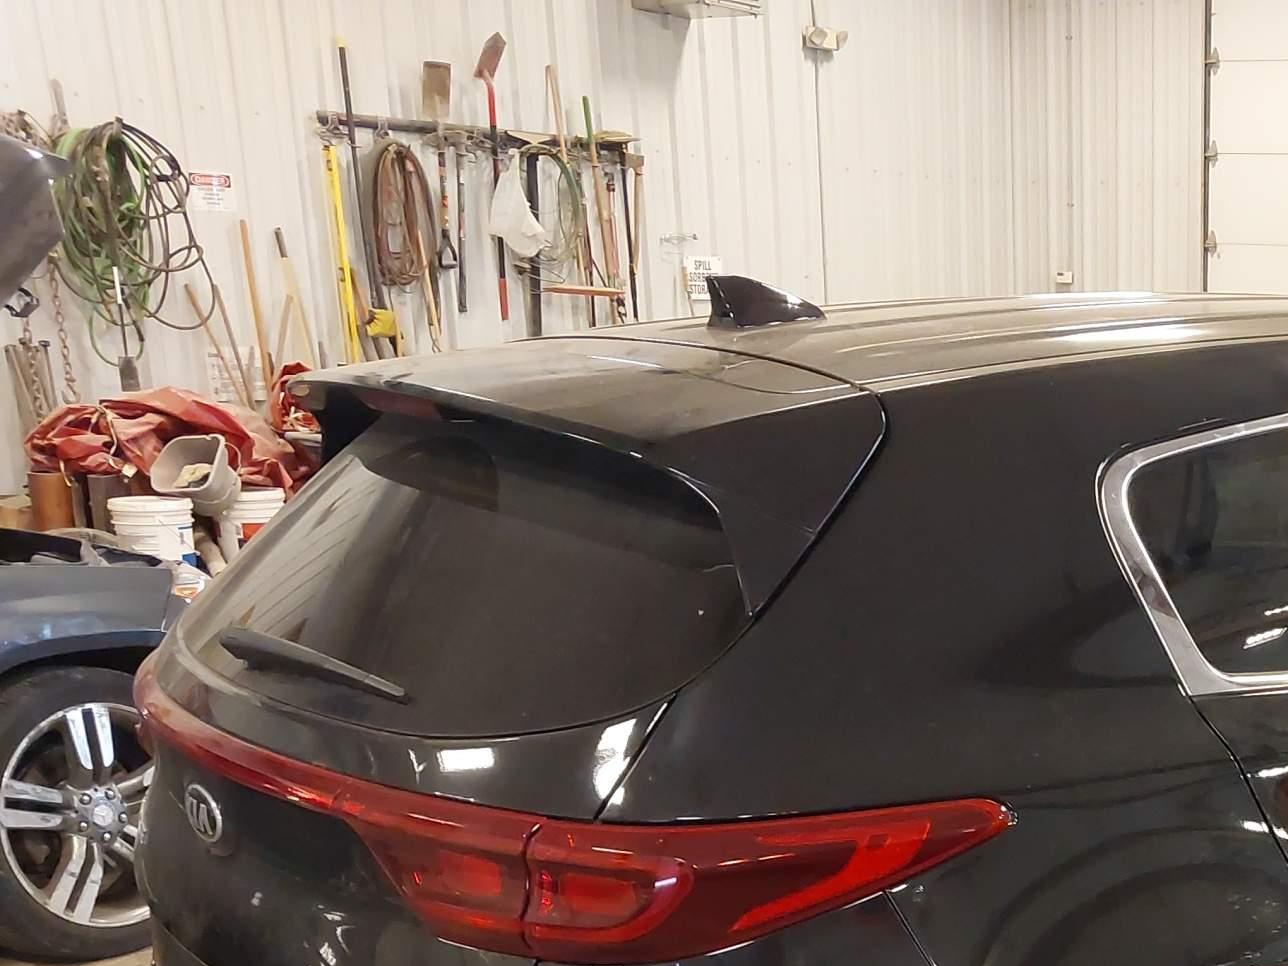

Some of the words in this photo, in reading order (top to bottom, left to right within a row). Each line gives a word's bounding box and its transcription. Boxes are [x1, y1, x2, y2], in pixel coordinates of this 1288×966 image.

[694, 259, 712, 270] SPILL
[689, 271, 717, 282] SORB
[689, 284, 708, 295] STOR
